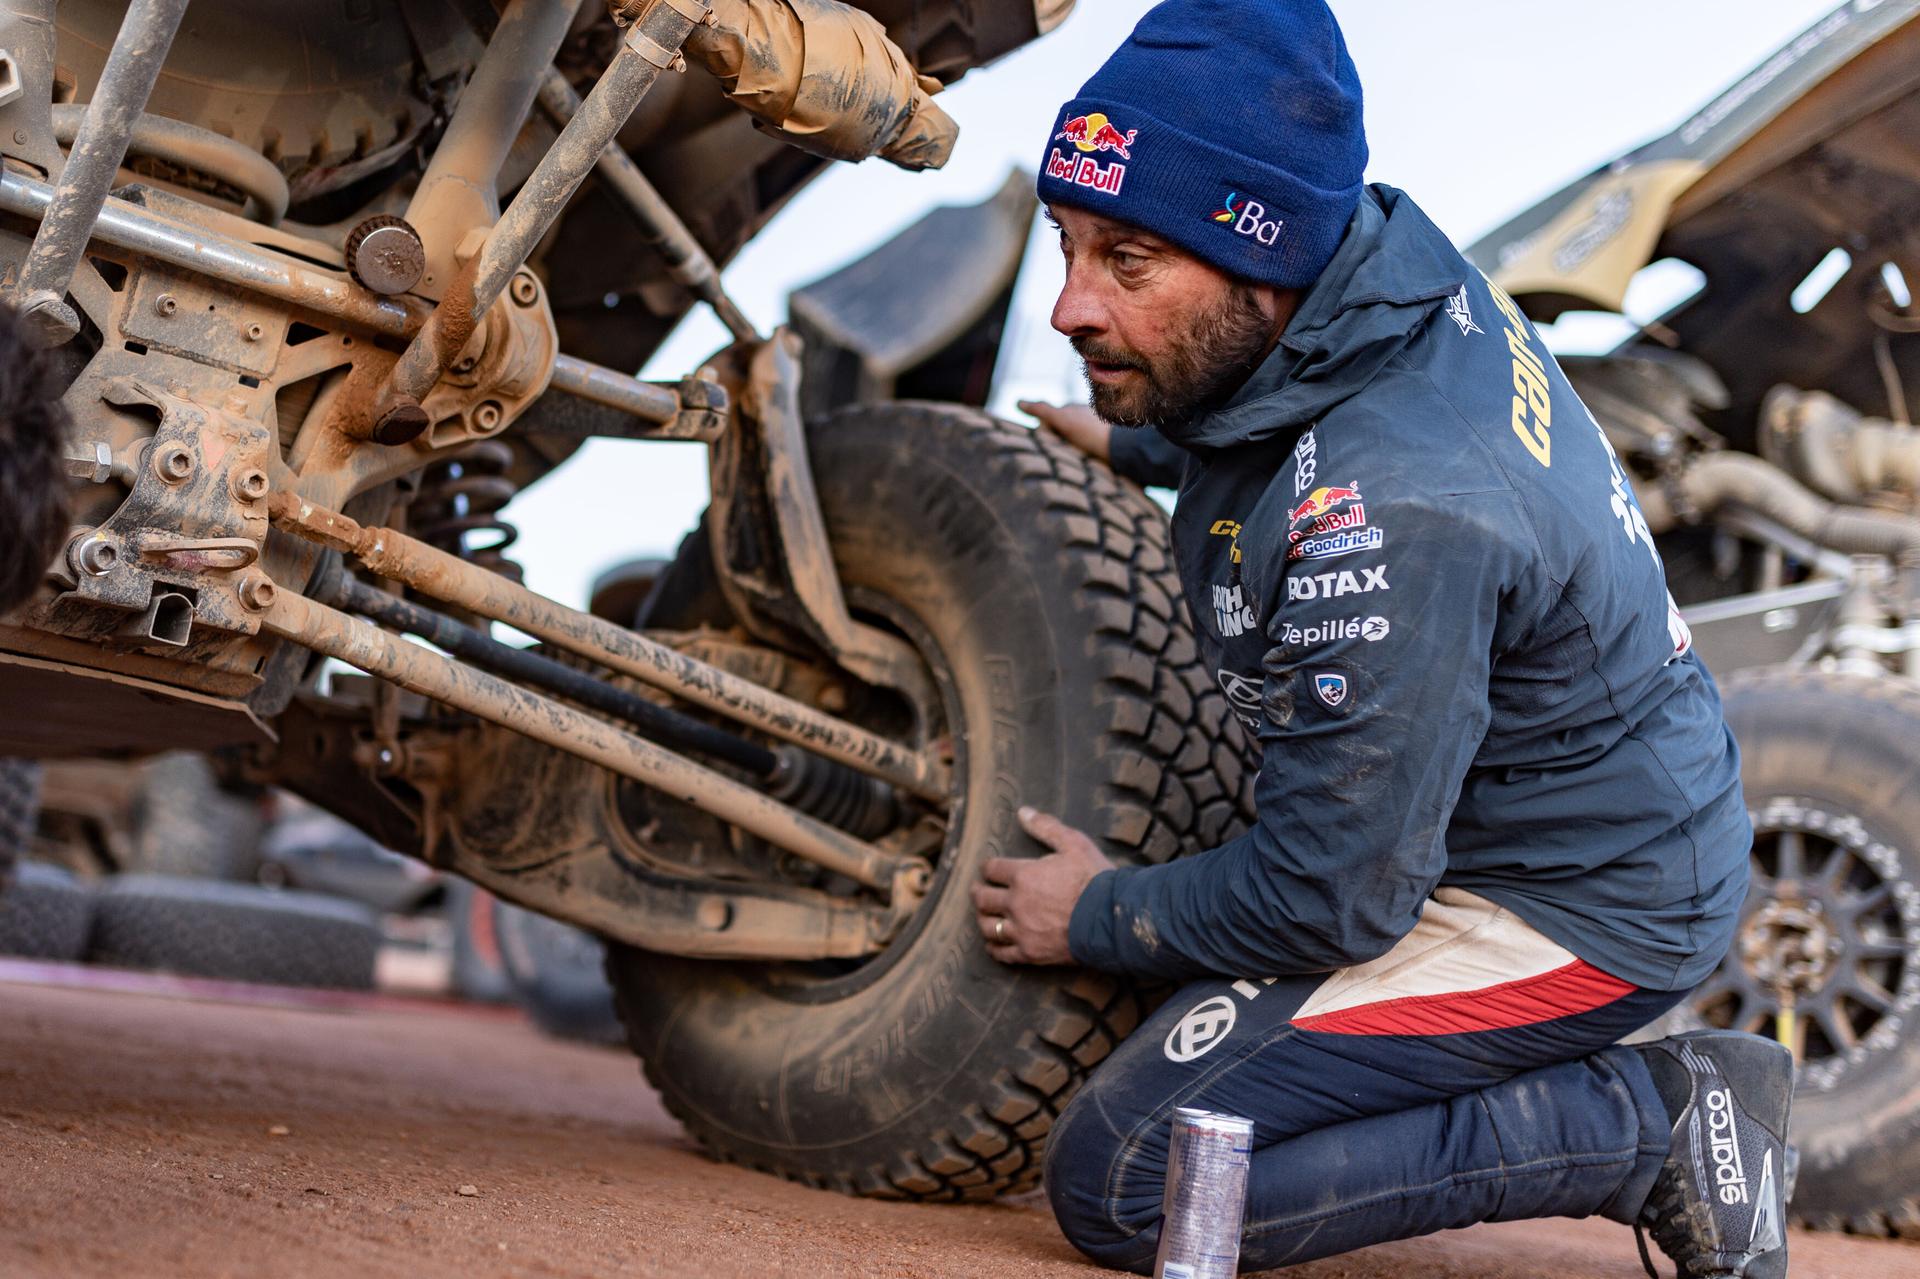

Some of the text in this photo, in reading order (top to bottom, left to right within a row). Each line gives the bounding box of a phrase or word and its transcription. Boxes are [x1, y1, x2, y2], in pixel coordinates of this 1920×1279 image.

[1046, 148, 1126, 195] Red Bull
[1234, 201, 1283, 246] Bci
[1325, 503, 1366, 533] Bull
[1706, 1088, 1747, 1205] sparco
